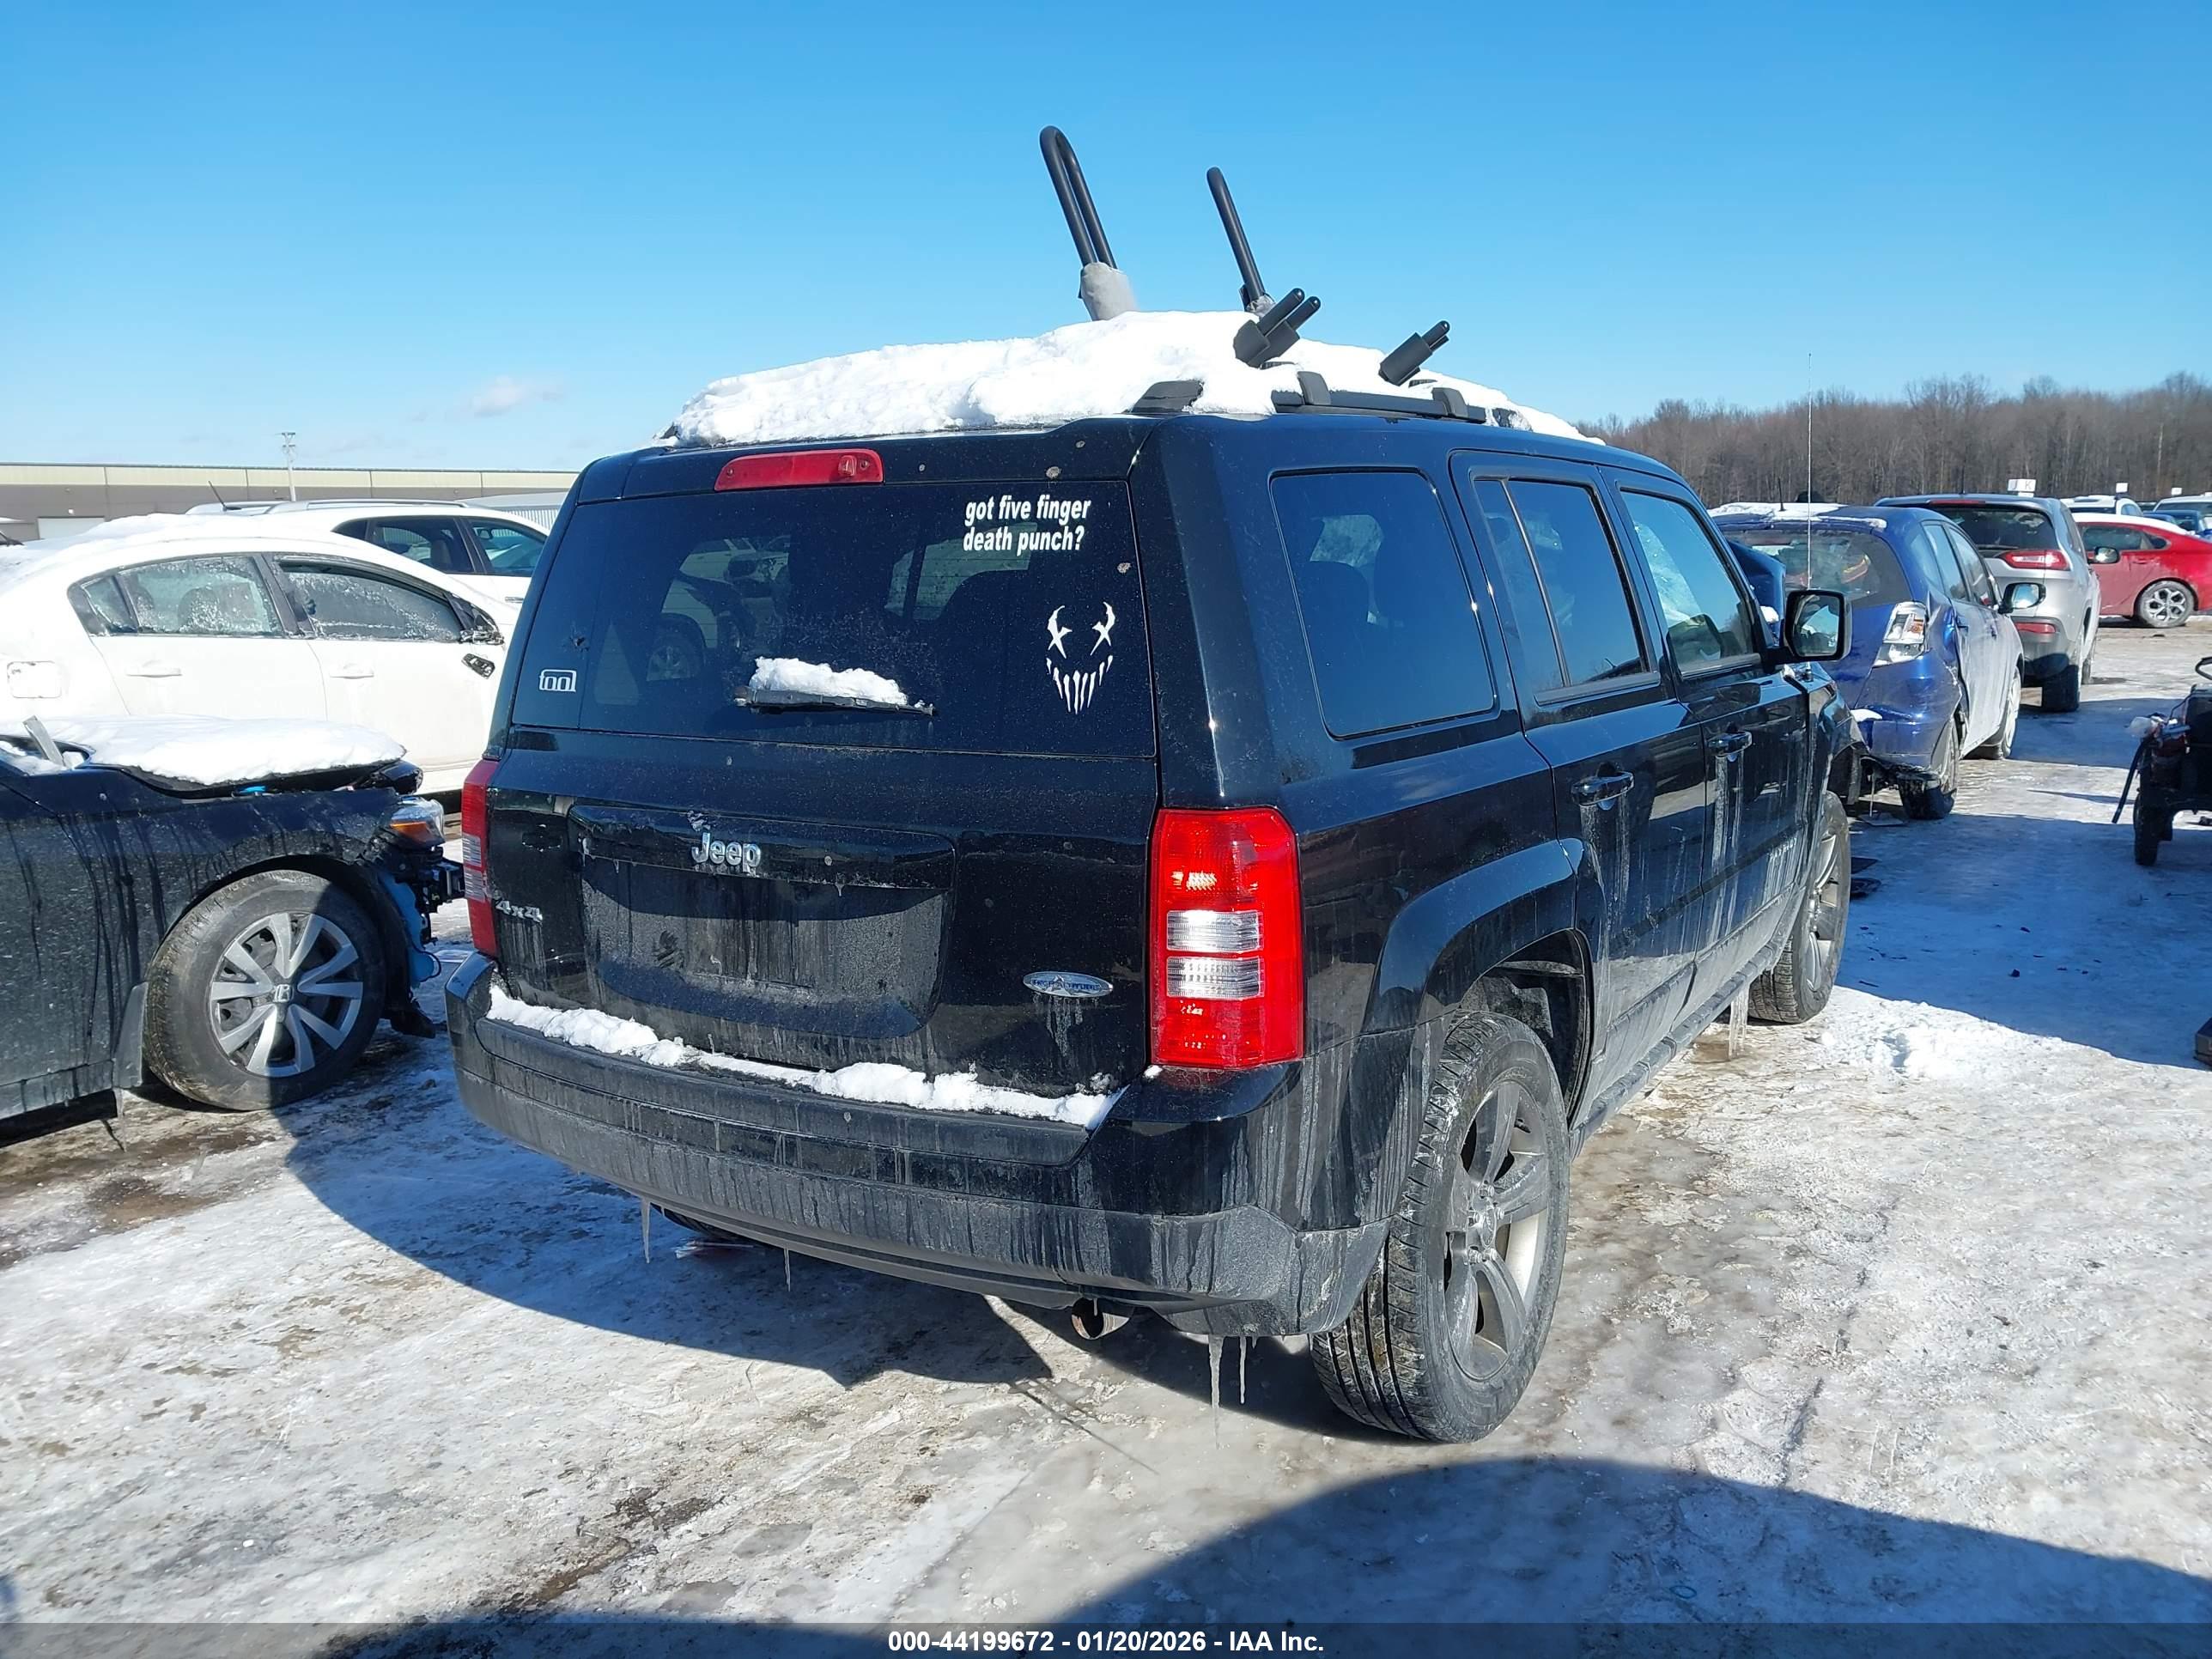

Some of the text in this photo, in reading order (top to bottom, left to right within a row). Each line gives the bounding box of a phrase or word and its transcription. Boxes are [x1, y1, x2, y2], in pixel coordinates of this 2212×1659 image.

[964, 495, 1091, 526] got five finger
[963, 526, 1085, 556] death punch?
[691, 832, 761, 873] Jeep
